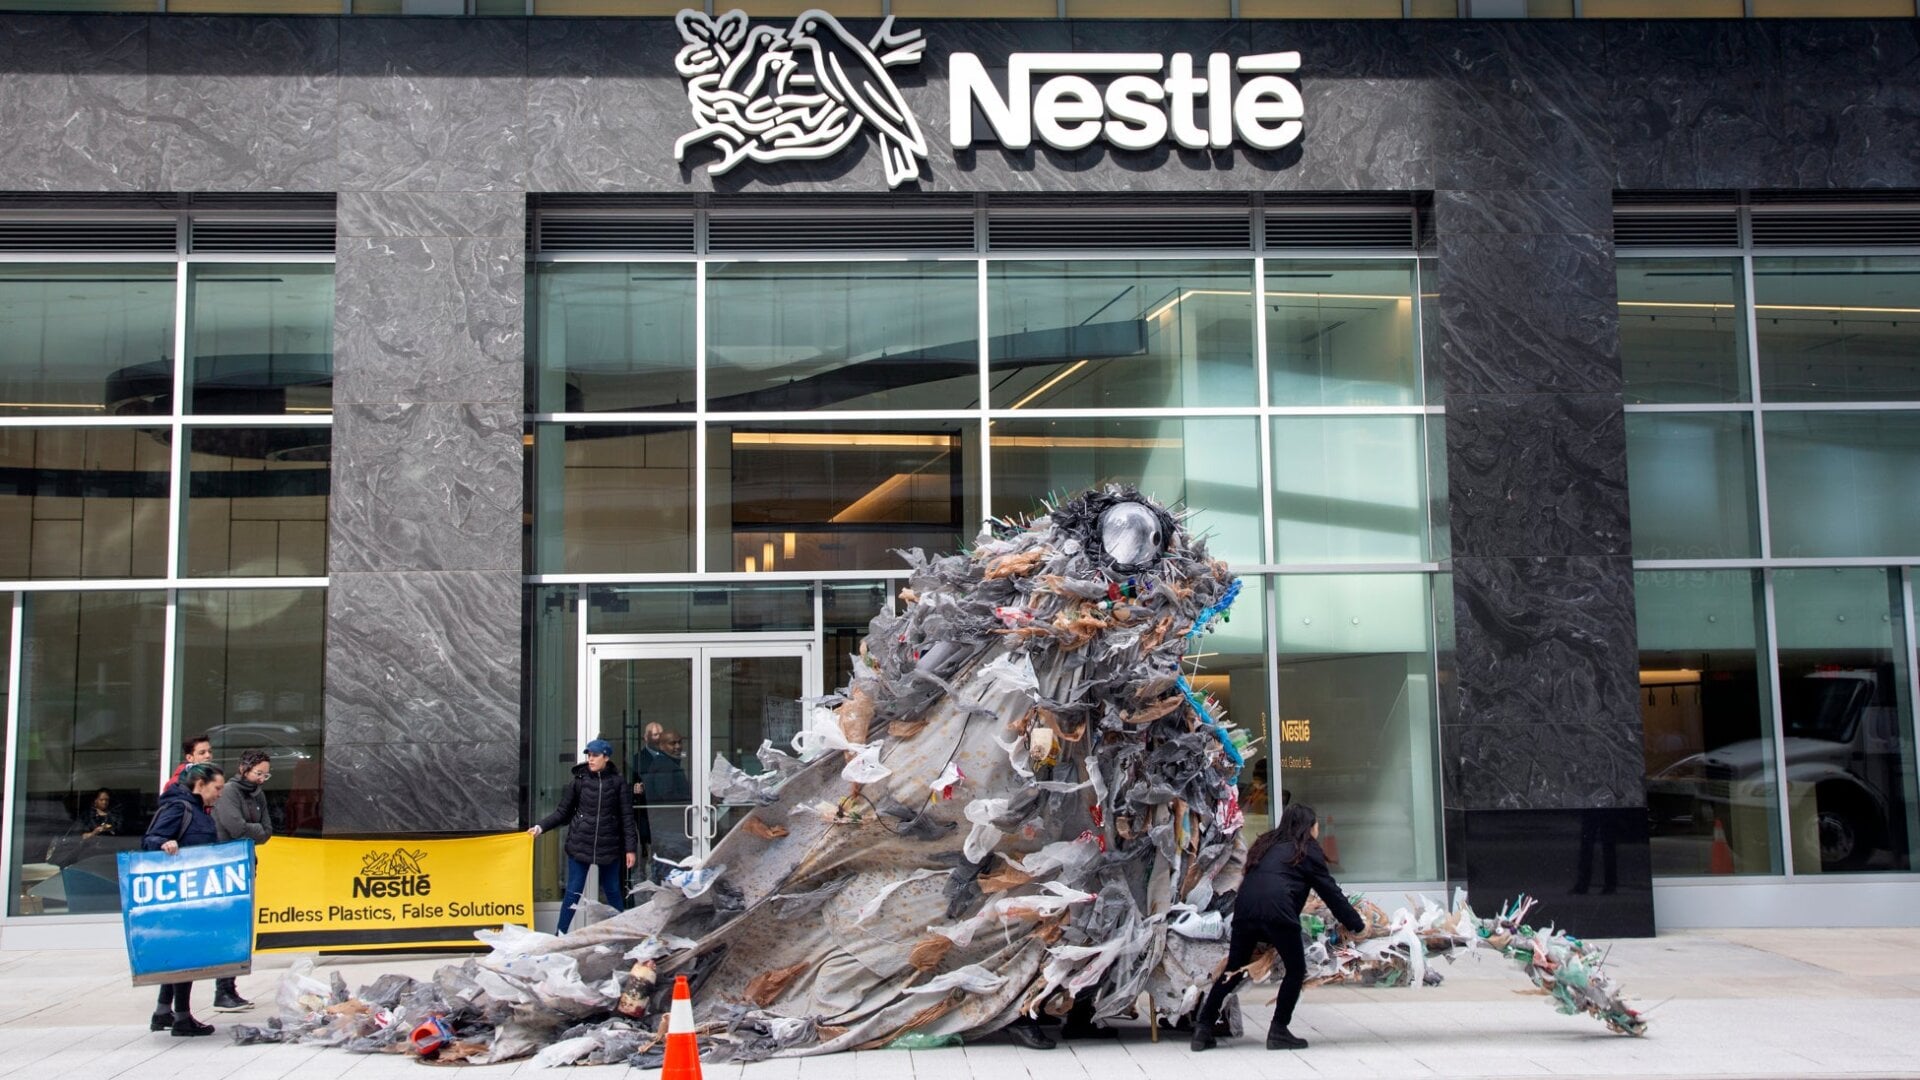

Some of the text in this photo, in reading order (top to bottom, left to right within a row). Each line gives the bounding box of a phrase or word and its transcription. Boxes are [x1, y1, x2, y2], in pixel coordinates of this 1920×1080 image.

[949, 51, 1304, 150] Nestlé
[1281, 719, 1311, 742] Nestlé
[132, 863, 247, 904] OCEAN
[352, 874, 431, 899] Nestlé
[258, 901, 525, 924] Endless Plastics, False Solutions
